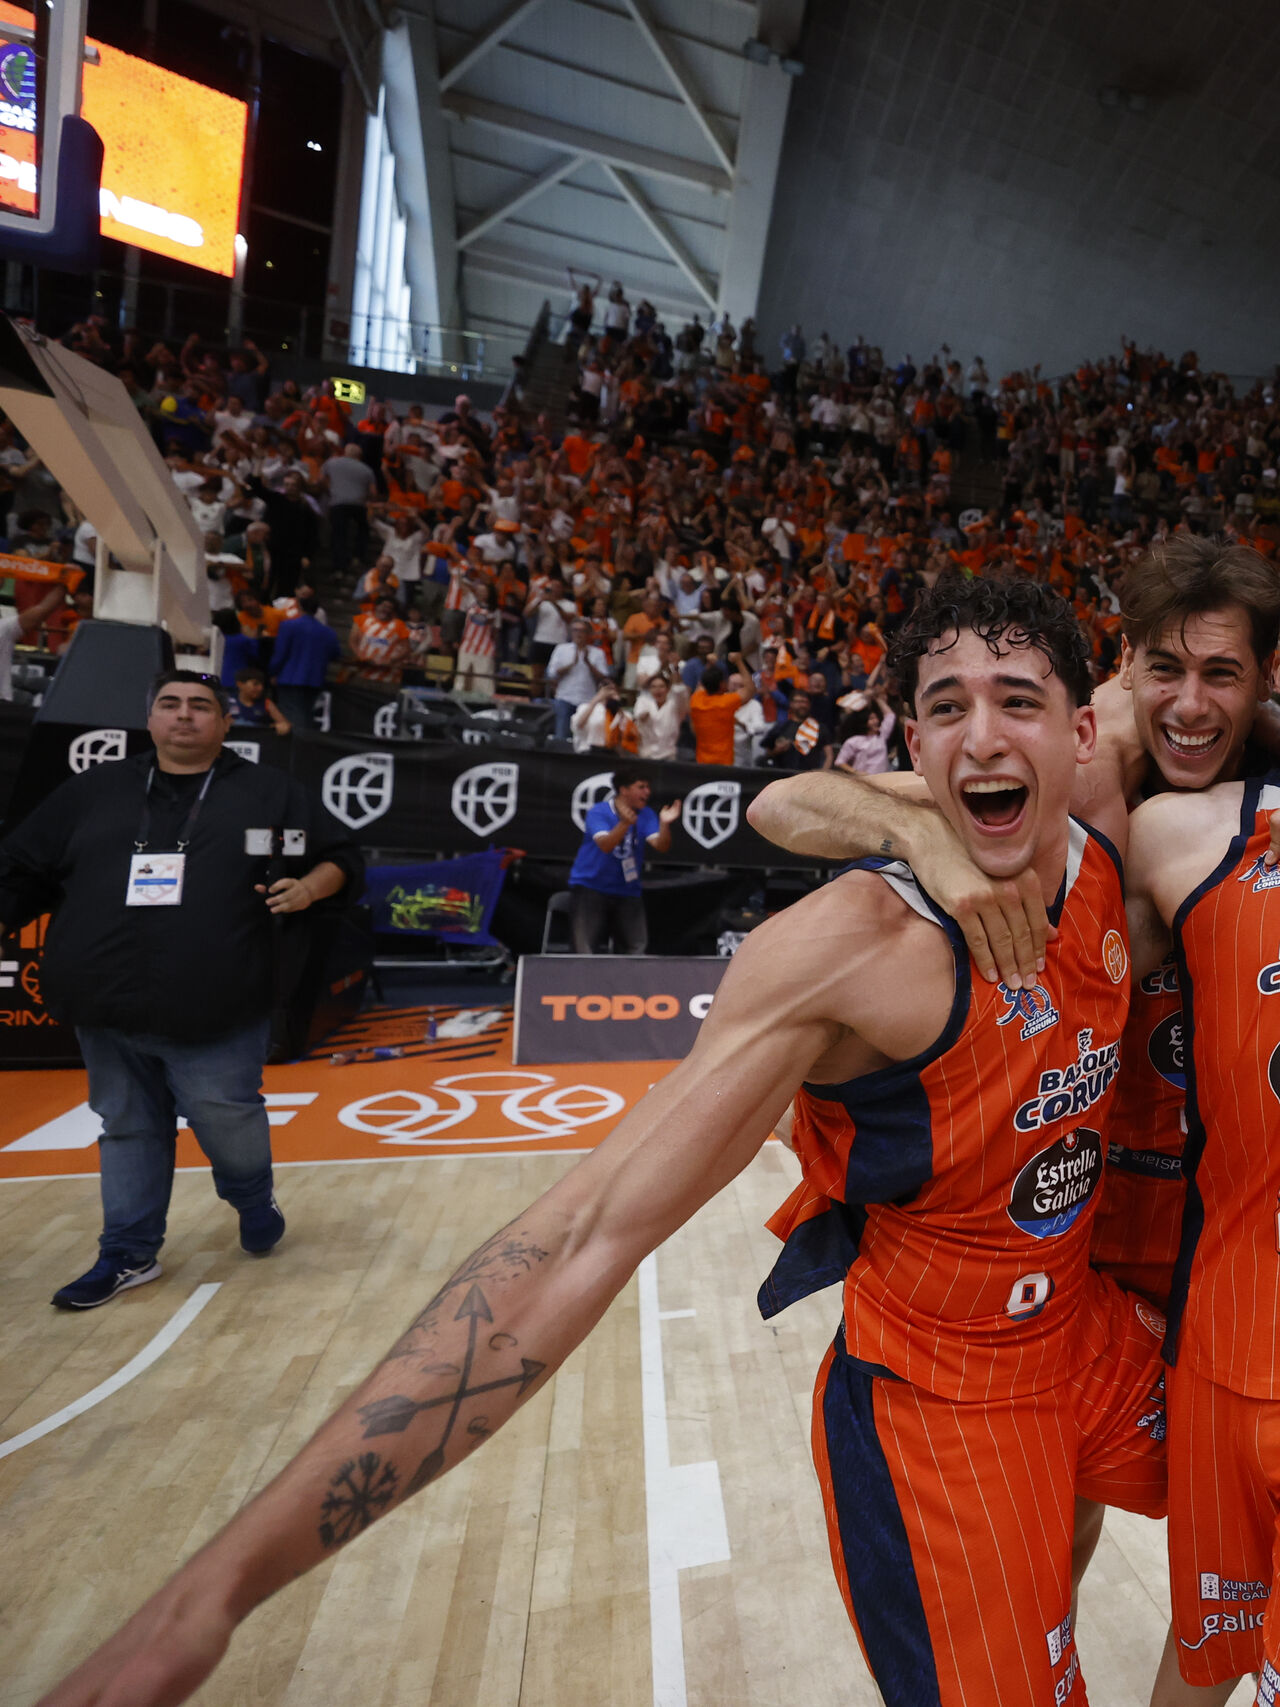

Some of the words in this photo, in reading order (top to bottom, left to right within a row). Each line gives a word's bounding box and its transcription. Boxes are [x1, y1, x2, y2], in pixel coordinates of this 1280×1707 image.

[541, 994, 681, 1021] TODO
[1035, 1149, 1097, 1190] Estrella
[1033, 1175, 1091, 1214] Galicia
[1222, 1580, 1265, 1591] XUNTA
[1222, 1591, 1239, 1600] DE
